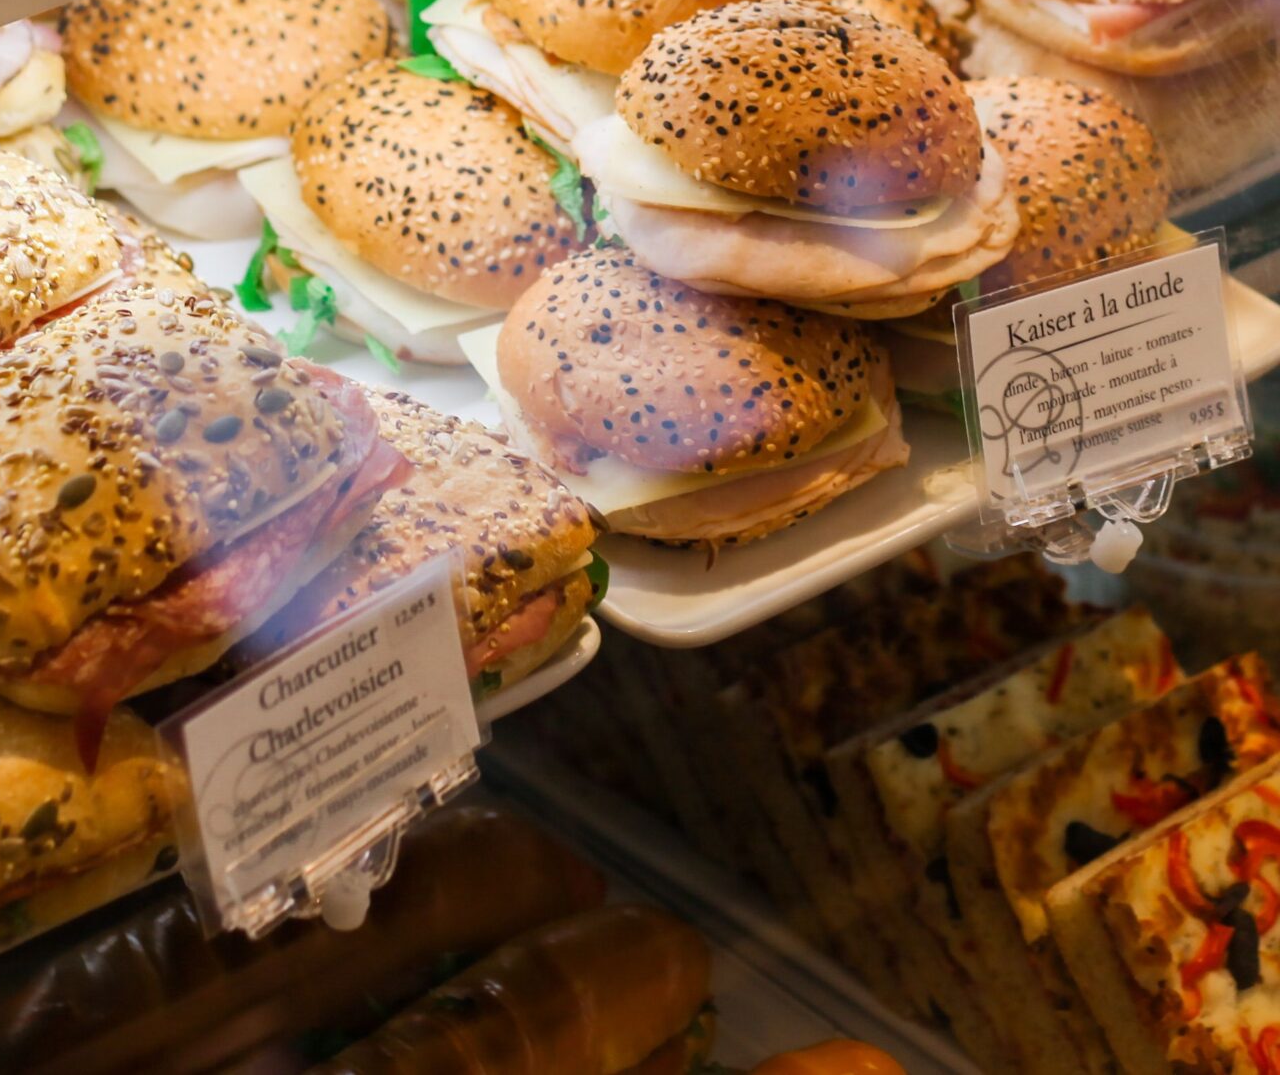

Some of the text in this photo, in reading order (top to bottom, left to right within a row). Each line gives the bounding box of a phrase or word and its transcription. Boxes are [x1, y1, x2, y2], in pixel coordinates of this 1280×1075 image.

[1007, 272, 1185, 348] Kaiser à la dinde
[1004, 376, 1039, 398] dinde
[1049, 361, 1089, 383] bacon
[1101, 346, 1133, 366] laitue
[1145, 326, 1193, 351] tomates
[1037, 384, 1096, 413] moutarde
[1108, 361, 1167, 389] moutarde
[1170, 357, 1177, 371] à
[1019, 415, 1082, 444] l'ancienne
[1093, 391, 1156, 419] mayonaise
[1161, 380, 1192, 401] pesto
[1072, 413, 1162, 452] fromage suisse
[1189, 405, 1213, 425] 9,95
[258, 624, 379, 710] Charcutier
[248, 657, 404, 764] Charlevoisien
